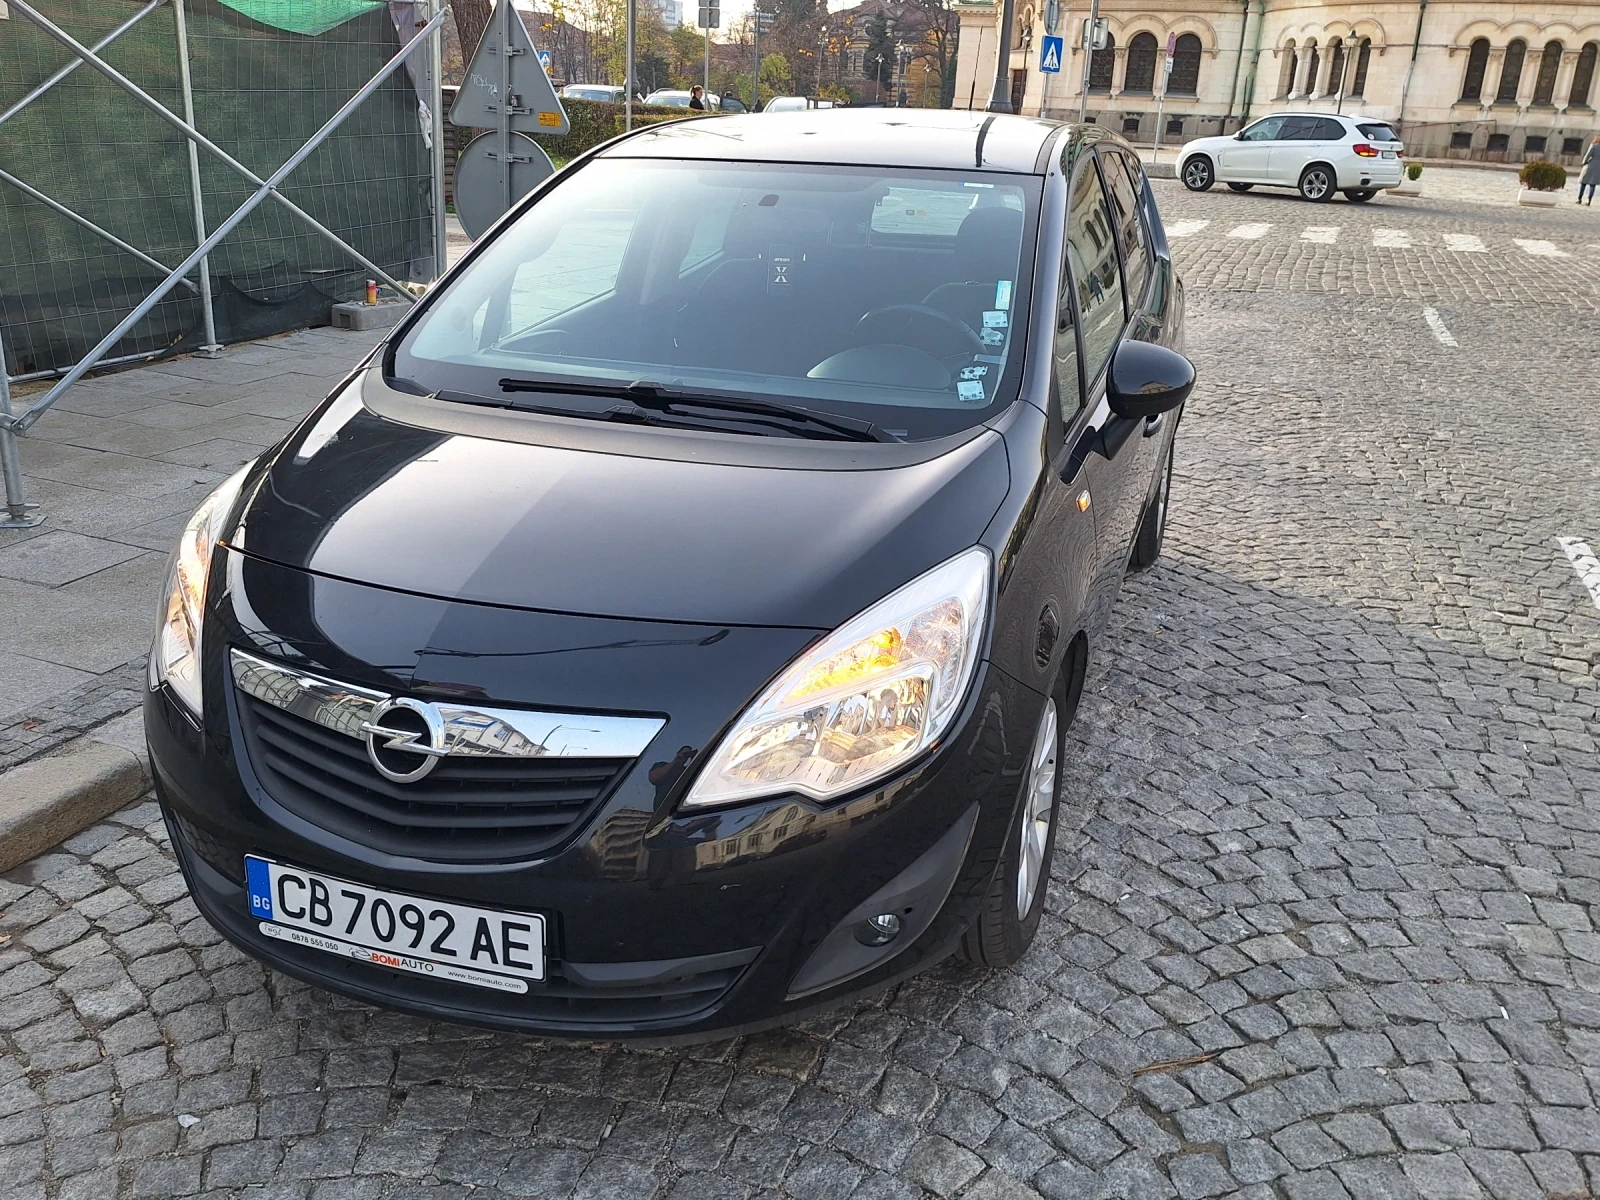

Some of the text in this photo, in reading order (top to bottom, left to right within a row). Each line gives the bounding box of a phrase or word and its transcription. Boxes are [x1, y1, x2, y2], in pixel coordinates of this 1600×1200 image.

[253, 894, 271, 910] BG
[277, 873, 533, 971] CB 7092 AE
[291, 932, 339, 951] 0878 555 050
[447, 970, 522, 990] www.bomiauto.com
